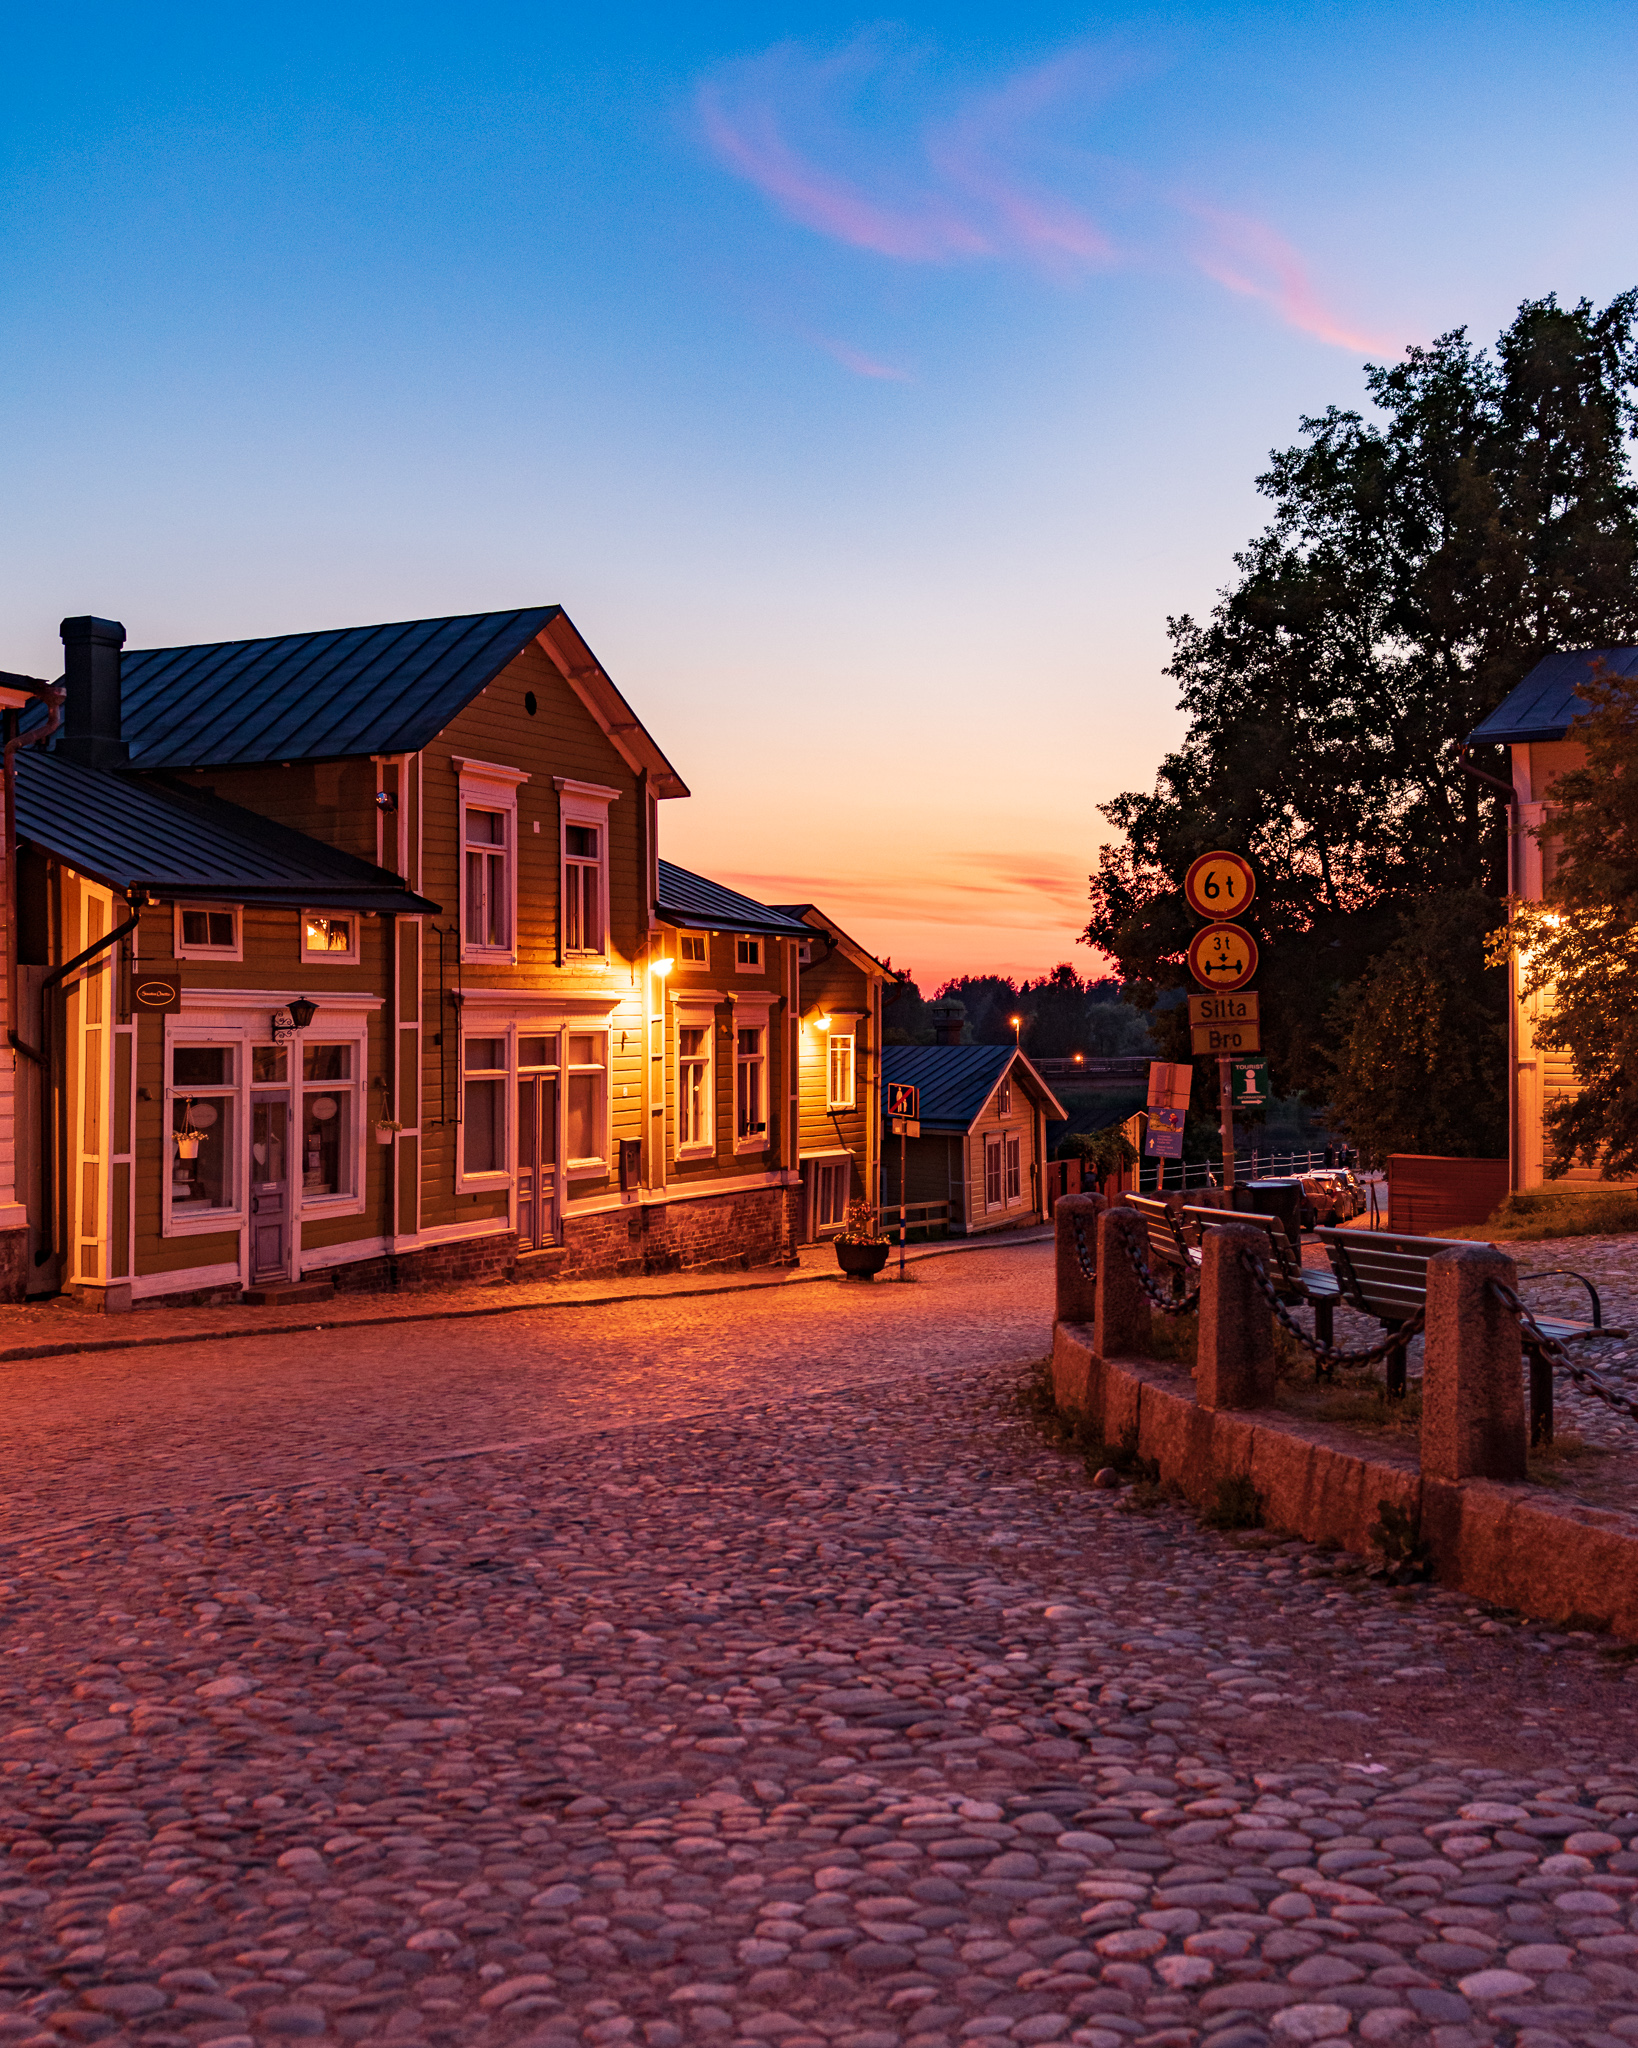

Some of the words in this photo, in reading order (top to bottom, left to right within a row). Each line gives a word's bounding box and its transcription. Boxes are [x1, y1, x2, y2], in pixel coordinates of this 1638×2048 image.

[1204, 872, 1220, 899] 6
[1226, 875, 1235, 898] t
[1213, 937, 1221, 950] 3
[1225, 937, 1230, 949] t
[1200, 999, 1247, 1019] Silta
[1209, 1030, 1242, 1049] Bro
